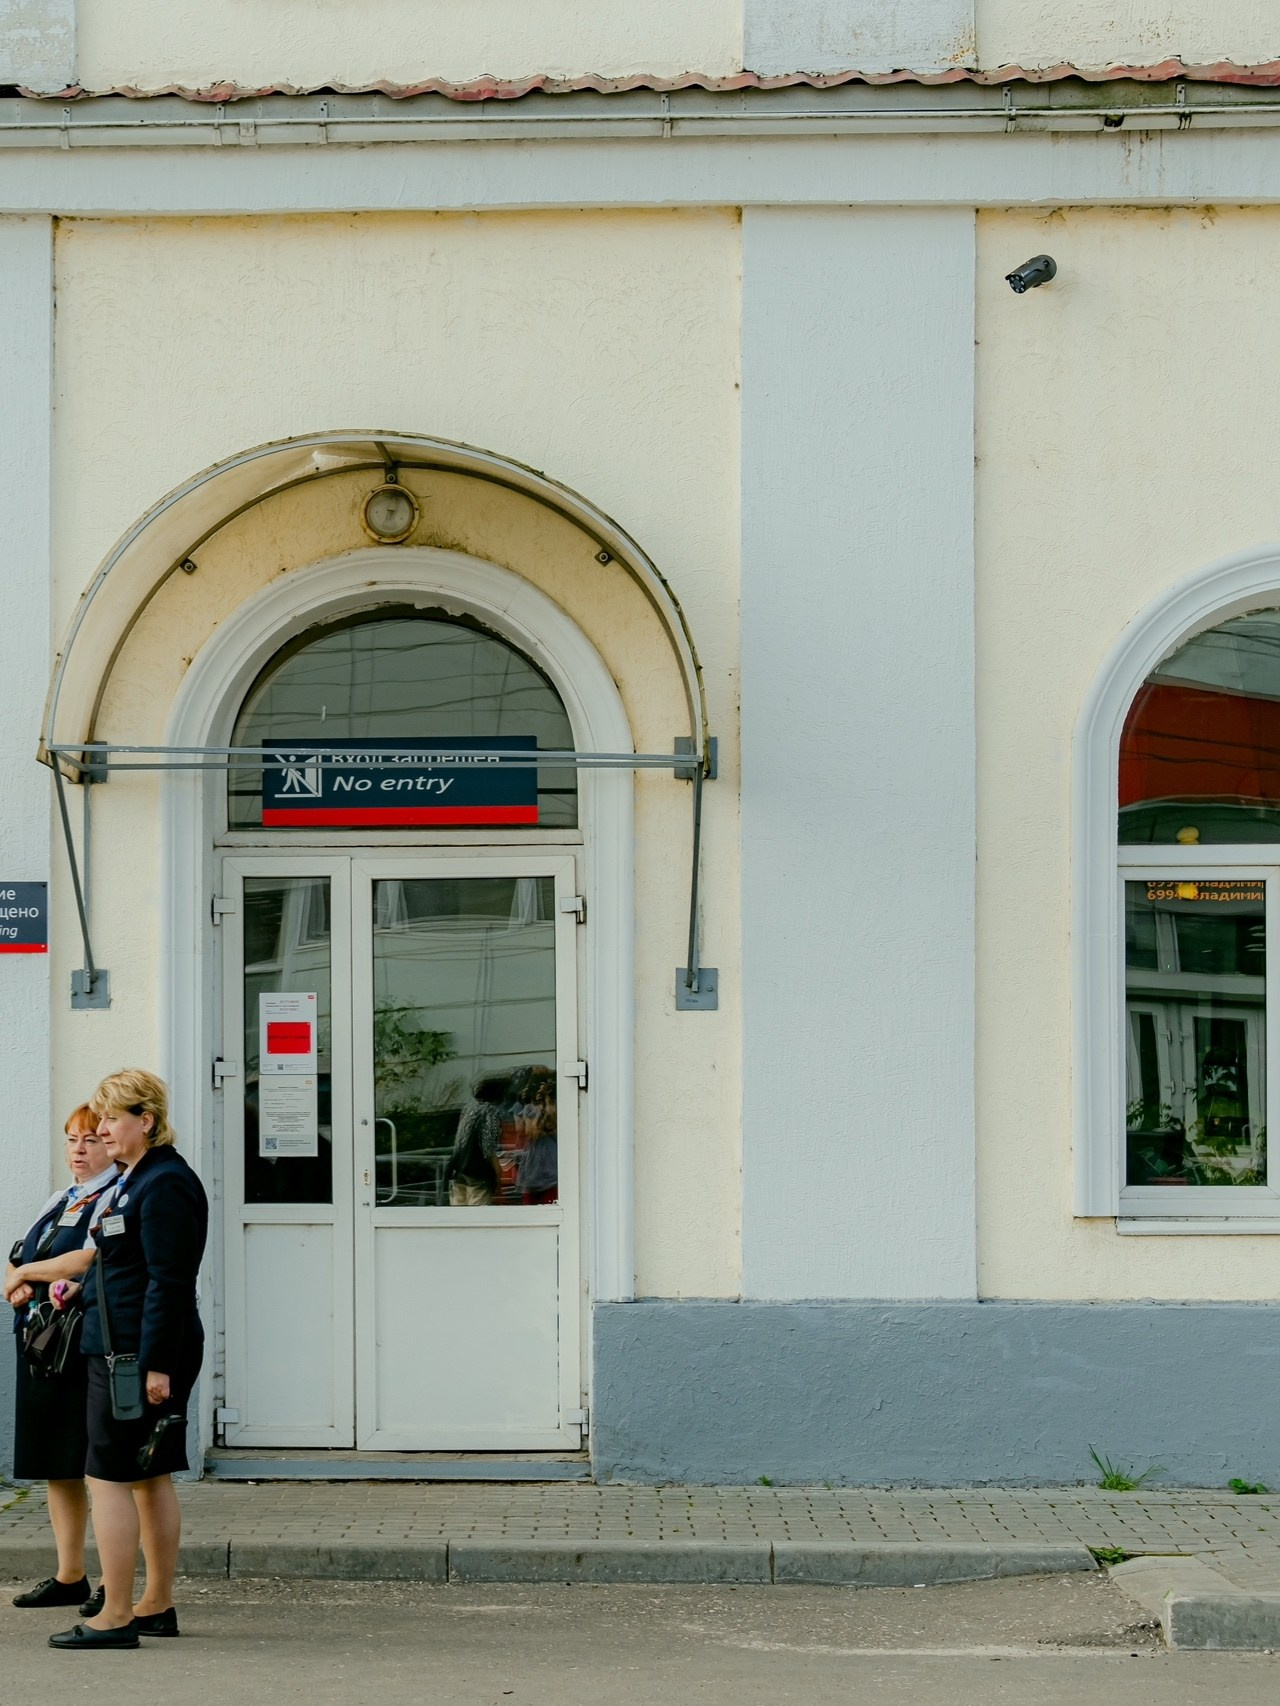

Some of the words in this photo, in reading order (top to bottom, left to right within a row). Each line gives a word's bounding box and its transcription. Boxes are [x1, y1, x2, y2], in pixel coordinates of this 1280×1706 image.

[333, 776, 372, 791] No
[380, 776, 455, 794] entry
[1191, 890, 1264, 901] ладими
